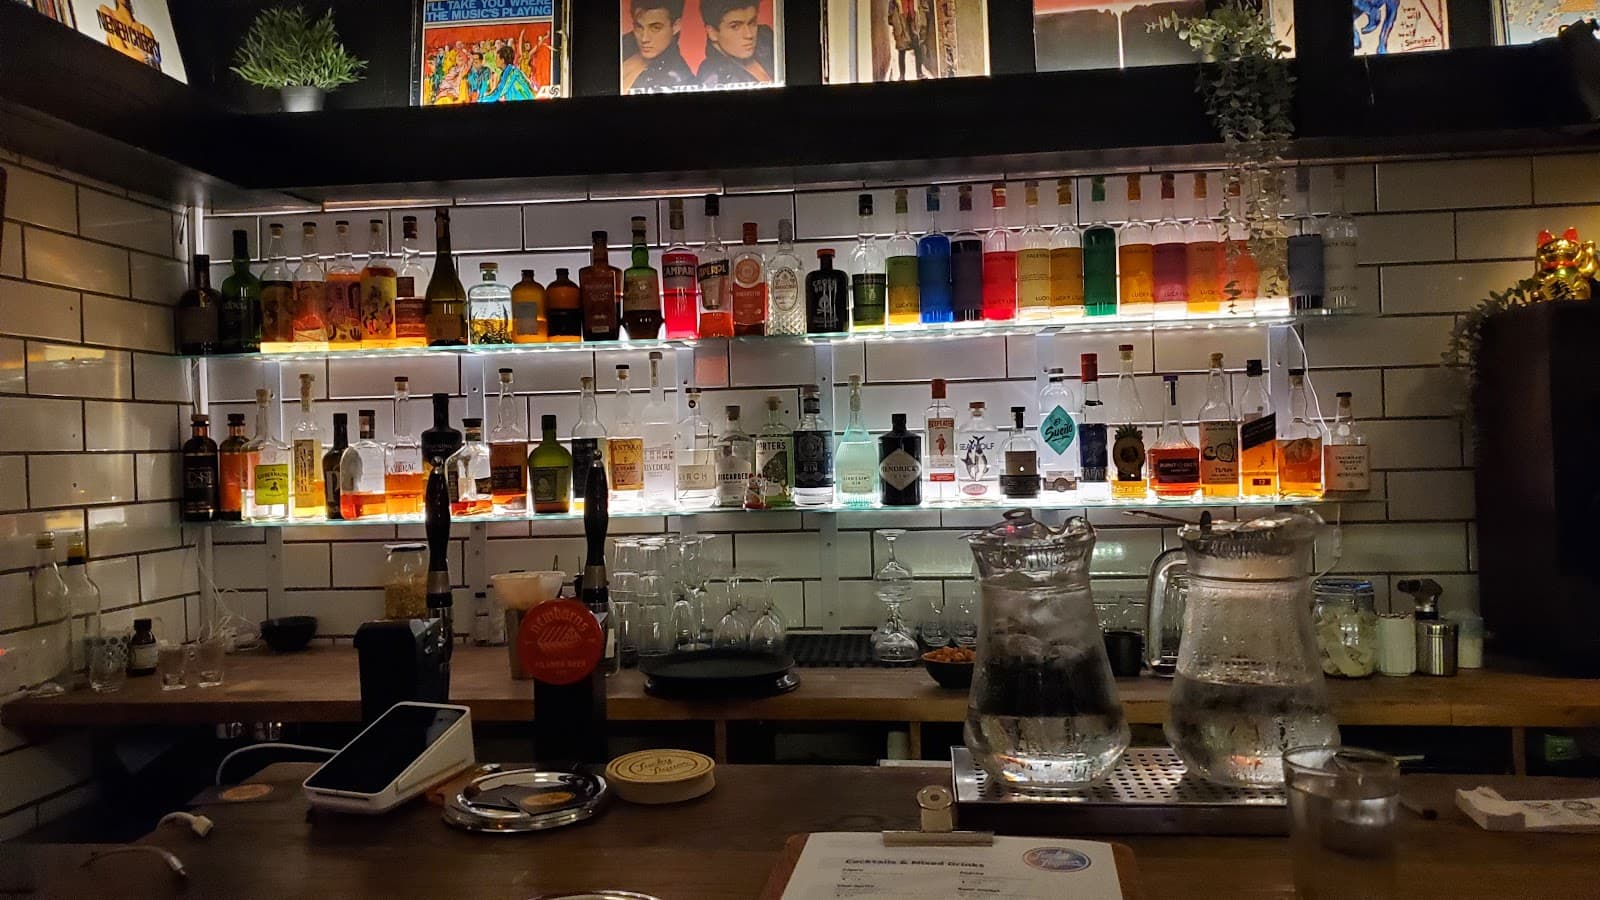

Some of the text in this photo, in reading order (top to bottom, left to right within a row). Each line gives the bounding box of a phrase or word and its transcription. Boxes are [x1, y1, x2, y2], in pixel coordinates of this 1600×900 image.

[426, 1, 445, 12] I'LL
[449, 0, 477, 9] TAKE
[482, 0, 505, 8] YOU
[427, 6, 551, 21] THE MUSIC'S PLAYING
[96, 9, 161, 62] NENEH CHERRY
[1044, 423, 1073, 443] Sueño
